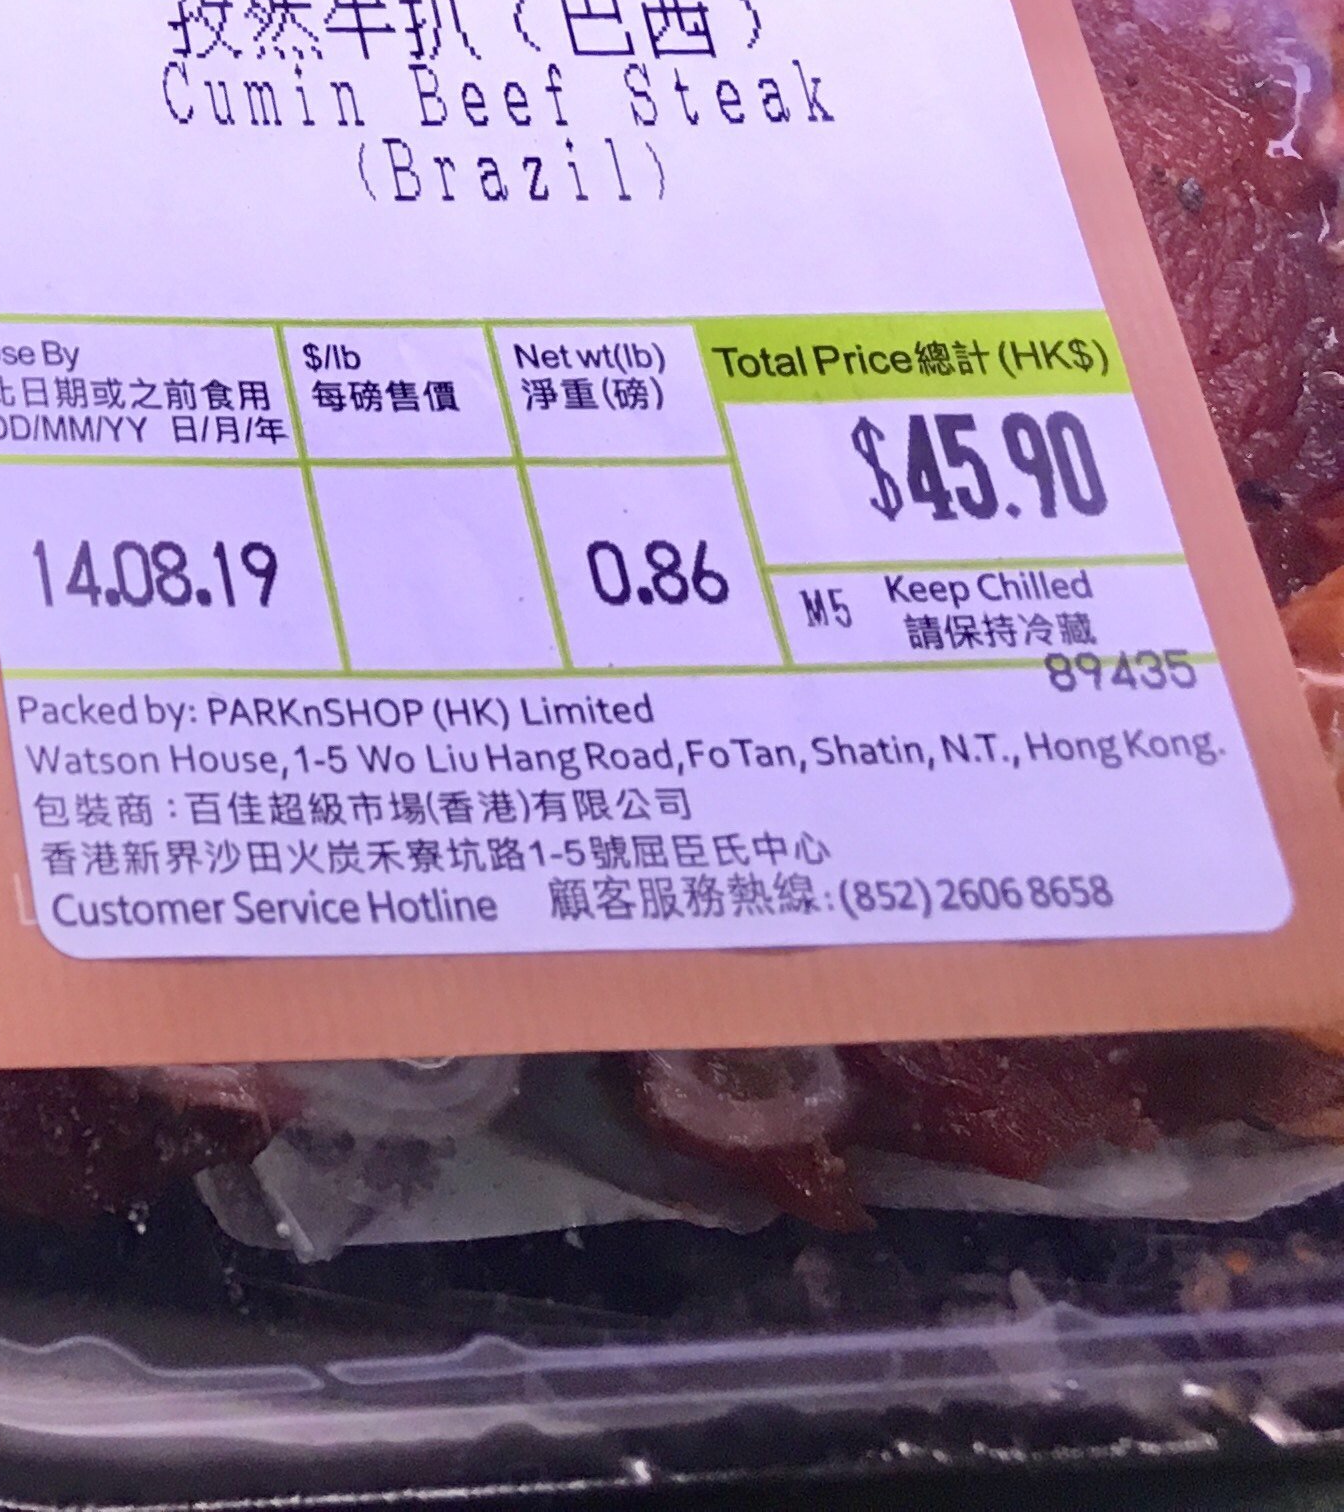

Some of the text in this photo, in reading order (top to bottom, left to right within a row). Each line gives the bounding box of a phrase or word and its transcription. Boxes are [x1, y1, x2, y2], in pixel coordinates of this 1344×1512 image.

[161, 59, 834, 126] Cumin Beef Steak
[357, 138, 667, 202] (Brazil)
[41, 339, 79, 372] By
[302, 342, 361, 373] $/lb
[512, 342, 666, 375] Net wt(lb)
[711, 345, 808, 379] Total
[998, 338, 1110, 380] (HK$)
[311, 379, 460, 414] 每磅售價
[522, 376, 667, 414] 淨重(磅)
[172, 415, 289, 445] 日/月/年
[851, 409, 1109, 522] $45.90
[31, 538, 277, 608] 14.08.19
[586, 540, 729, 606] 0.86
[885, 569, 1093, 608] Keep Chilled
[800, 588, 853, 629] M5
[903, 611, 1098, 651] 請保持冷藏
[1044, 648, 1198, 694] 89435
[17, 694, 655, 732] Packed by: PARKnSHOP (HK) Limited
[24, 745, 160, 775] Watson
[357, 745, 416, 774] Wo
[427, 744, 478, 774] Liu
[486, 745, 585, 783] Hang
[811, 735, 934, 771] Shatin,
[1024, 730, 1129, 768] Hong
[1127, 728, 1227, 766] Kong.
[51, 891, 226, 927] Customer
[233, 890, 360, 925] Service
[368, 888, 499, 924] Hotline
[939, 874, 1024, 912] 2606
[1028, 872, 1115, 908] 8658
